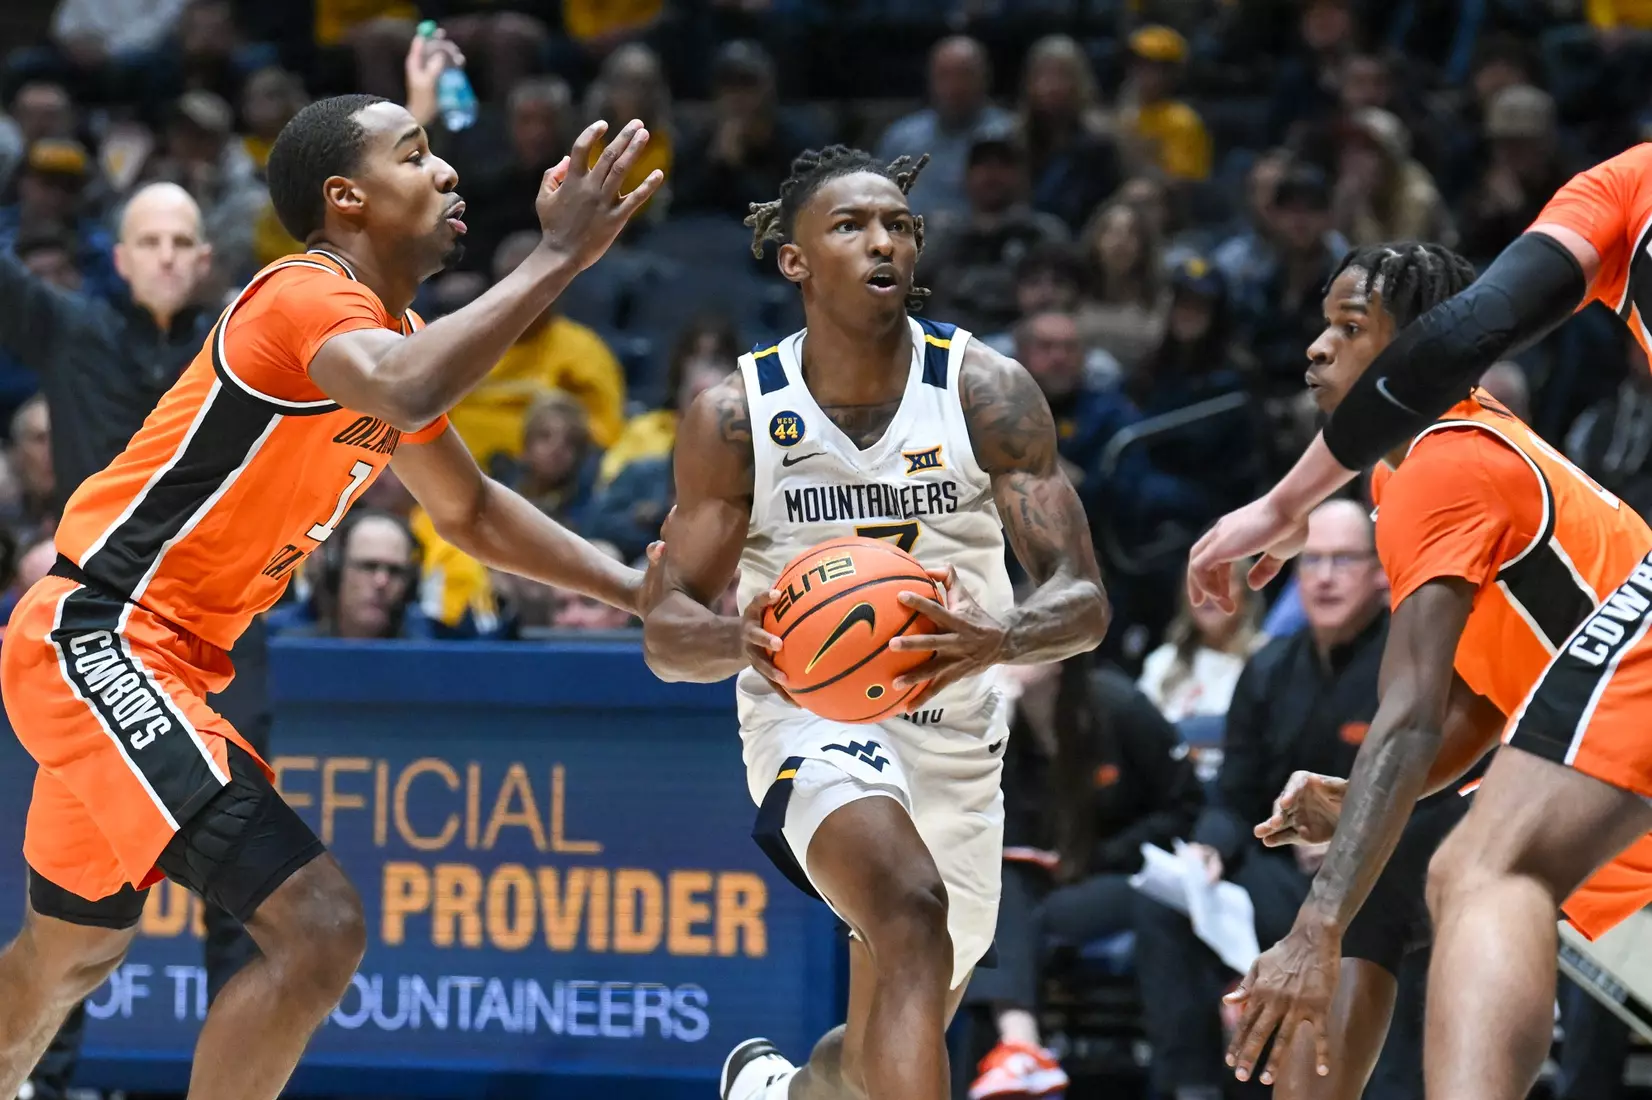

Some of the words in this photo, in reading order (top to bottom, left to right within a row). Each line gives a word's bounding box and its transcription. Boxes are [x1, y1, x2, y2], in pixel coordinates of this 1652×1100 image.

[774, 423, 799, 440] 44
[776, 417, 798, 425] WEST
[305, 459, 374, 543] 1
[784, 481, 958, 523] MOUNTAINEERS
[773, 555, 856, 624] ELITE
[69, 630, 172, 750] COWBOYS
[270, 757, 604, 854] FFICIAL
[381, 860, 768, 958] PROVIDER
[325, 970, 710, 1043] OUNTAINEERS
